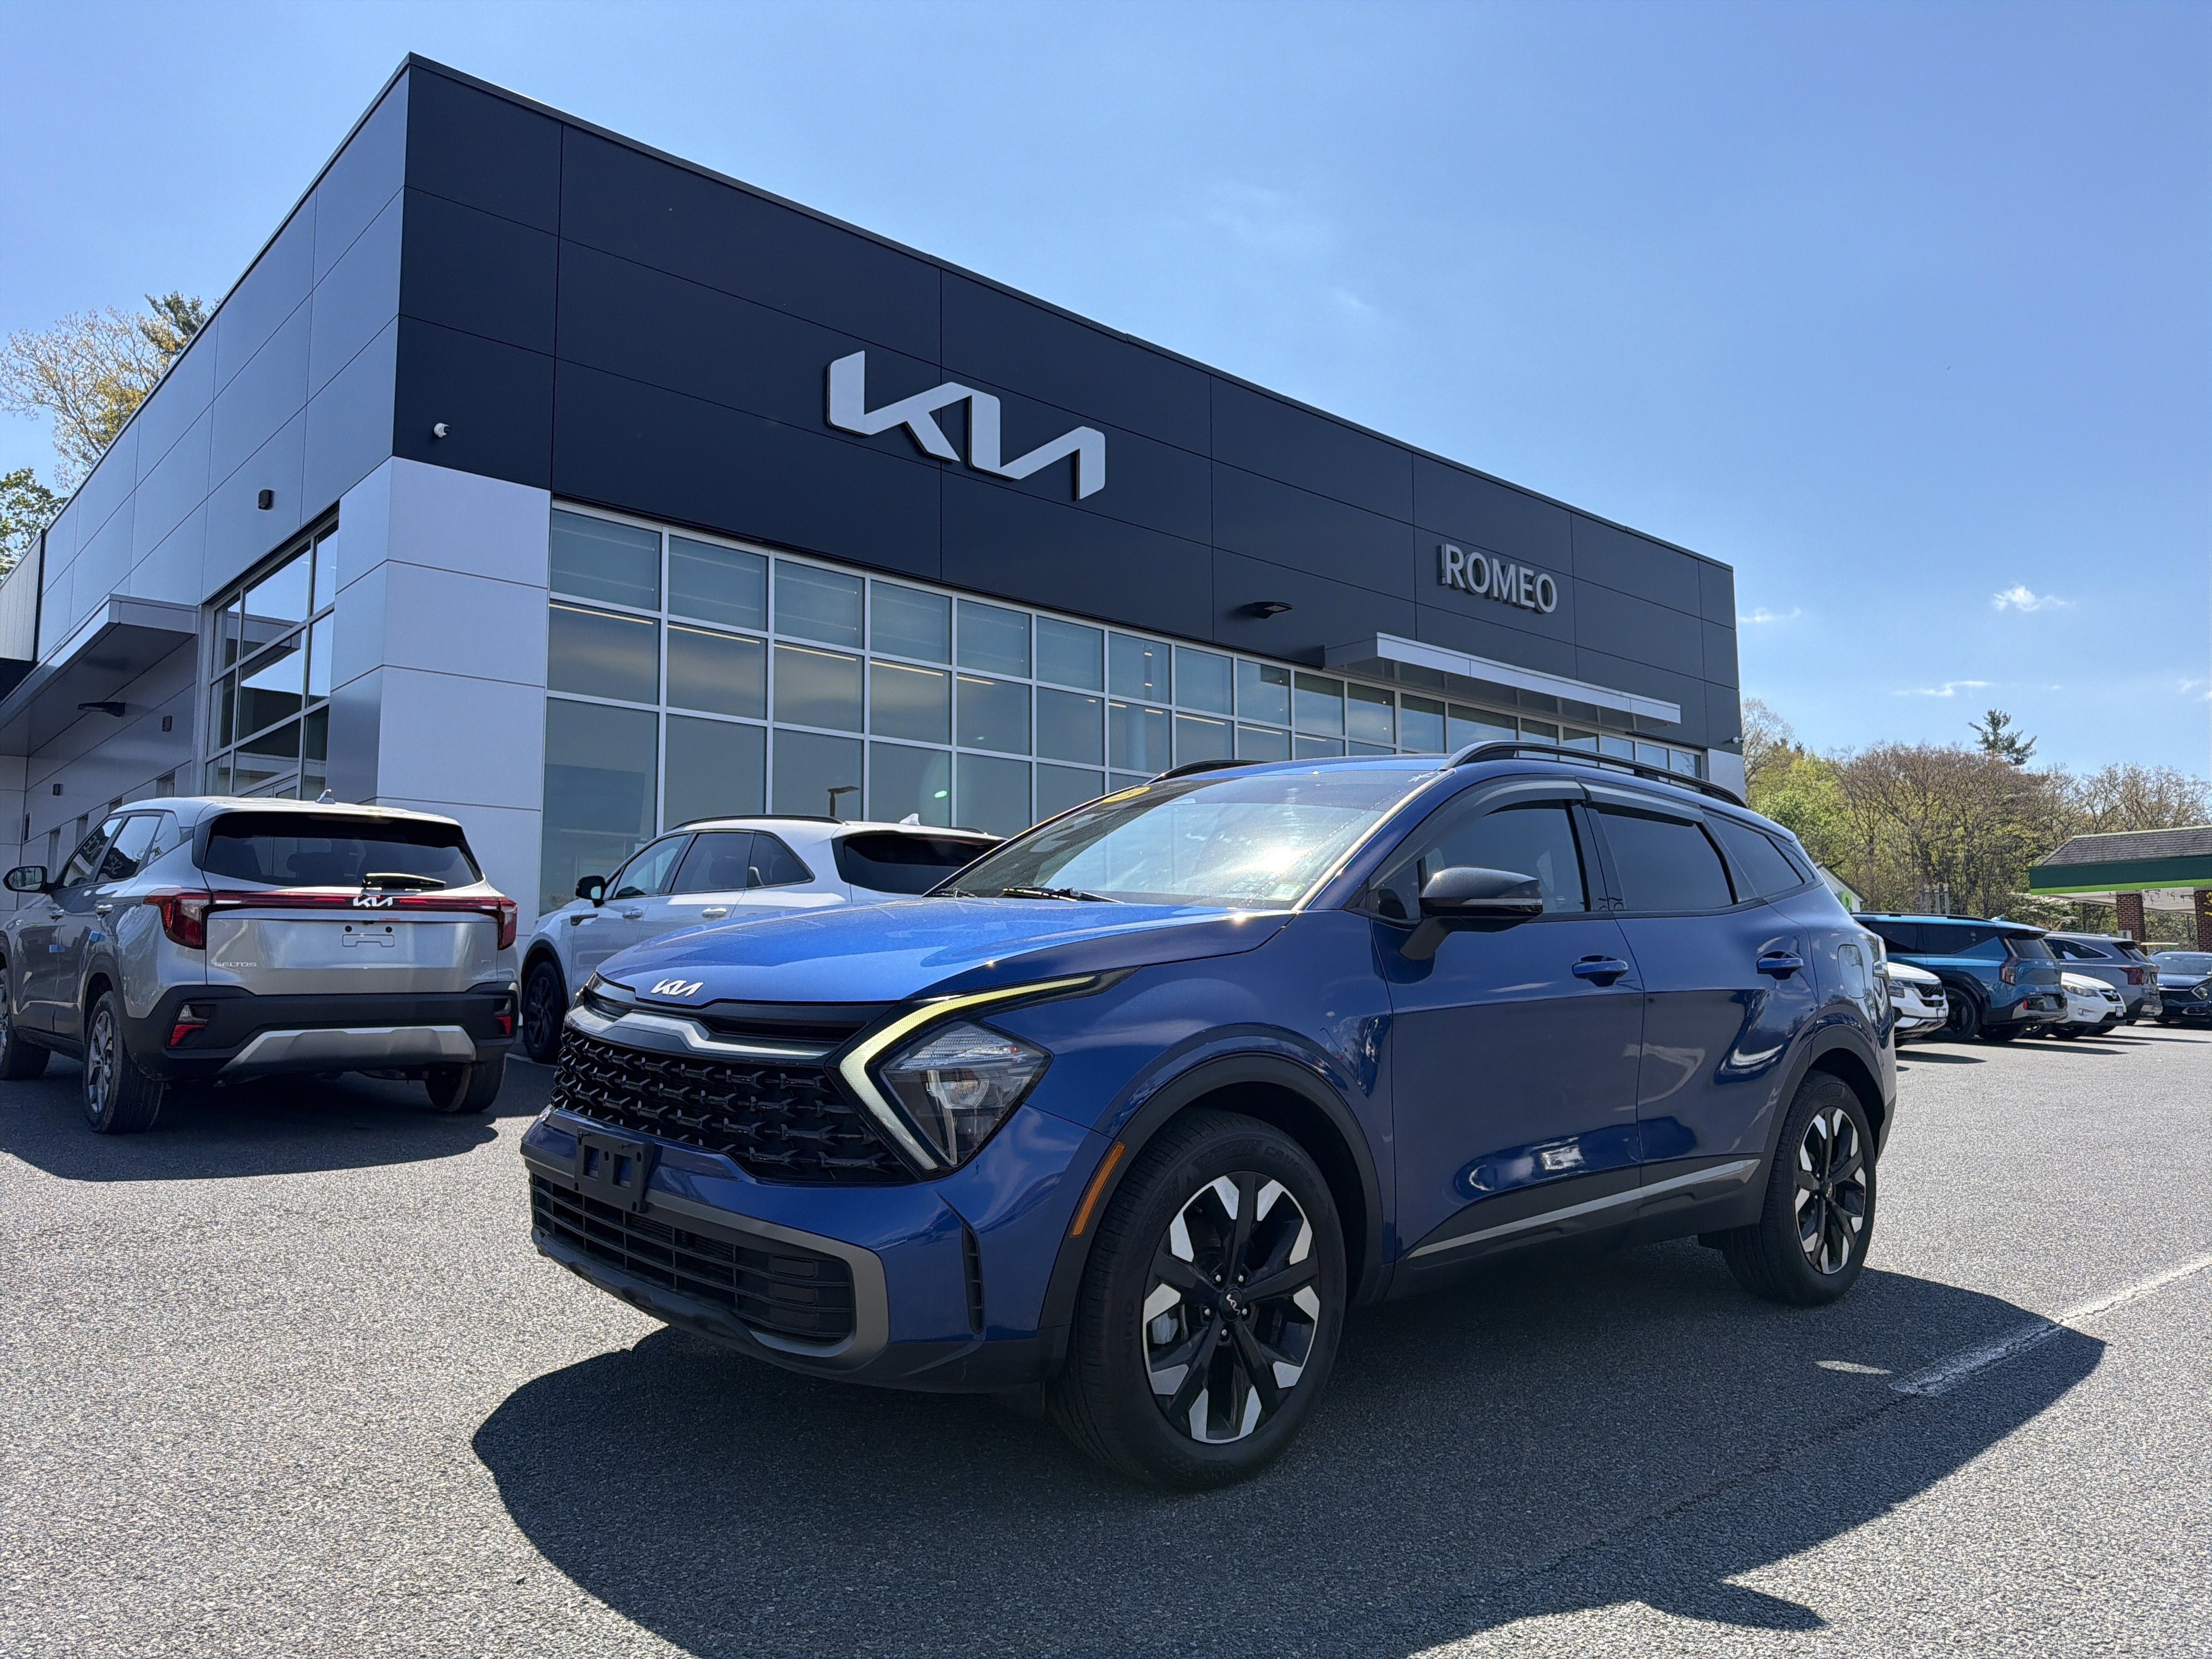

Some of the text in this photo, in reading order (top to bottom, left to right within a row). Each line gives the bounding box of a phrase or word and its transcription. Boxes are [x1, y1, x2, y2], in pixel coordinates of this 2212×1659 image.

[827, 350, 1105, 500] KIA
[1442, 544, 1558, 613] ROMEO
[353, 896, 393, 908] KIA
[650, 978, 704, 997] KIA
